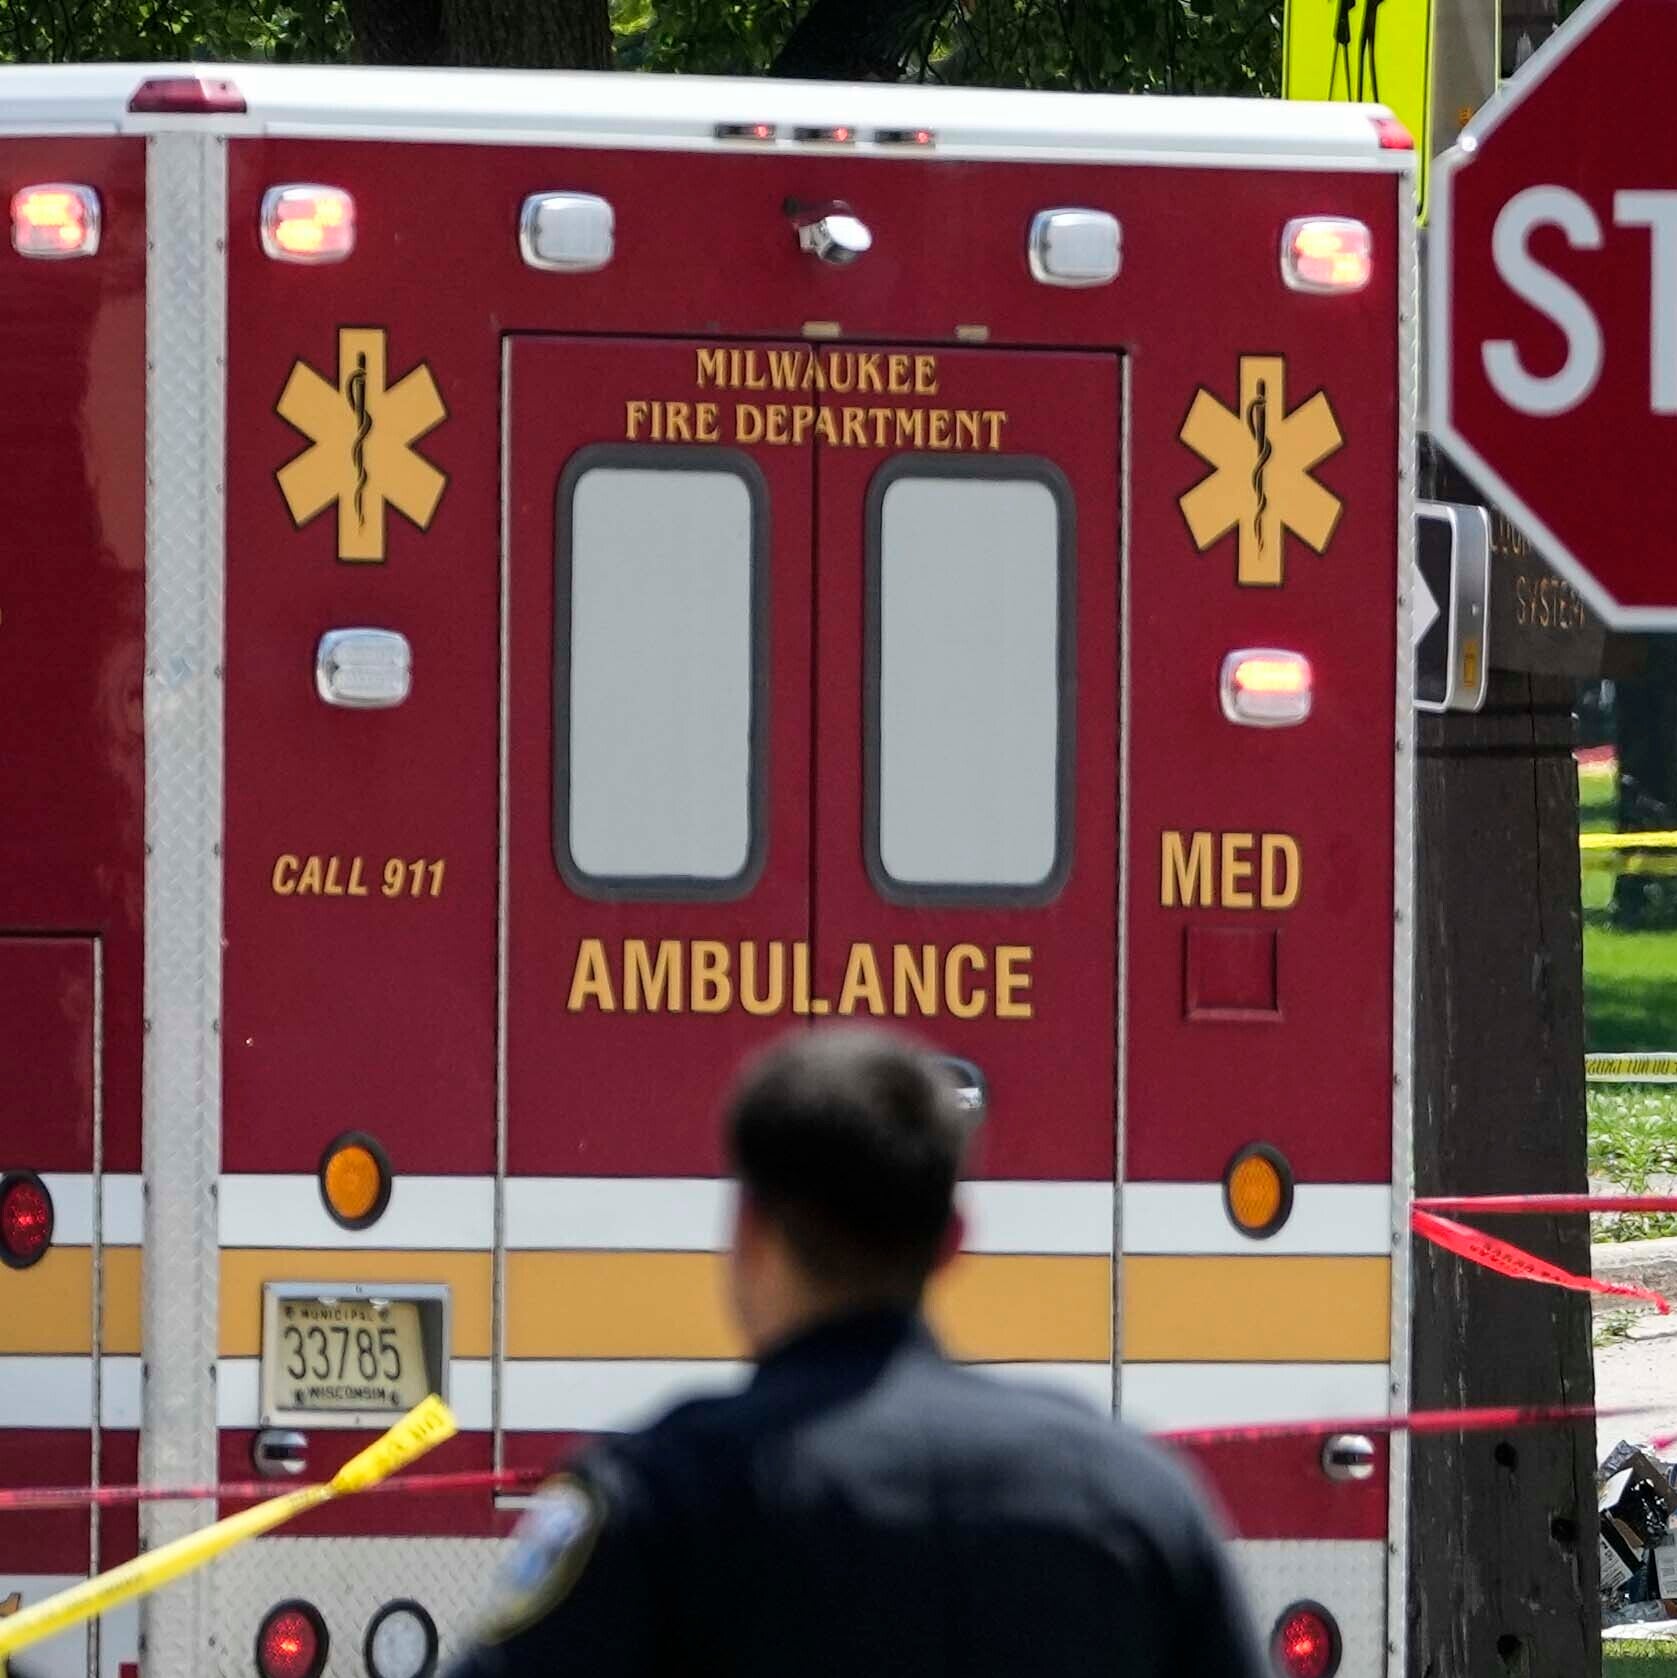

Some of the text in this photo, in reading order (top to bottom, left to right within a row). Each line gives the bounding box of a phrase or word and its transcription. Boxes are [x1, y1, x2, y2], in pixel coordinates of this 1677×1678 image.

[696, 348, 940, 395] MILWAUKEE
[625, 400, 1007, 450] FIRE DEPARTMENT
[272, 854, 445, 898] CALL 911
[1161, 831, 1300, 910] MED
[566, 937, 1034, 1020] AMBULANCE
[301, 1309, 374, 1322] MUNICIPAL
[284, 1324, 402, 1381] 33785
[306, 1385, 386, 1401] WISCONSIN
